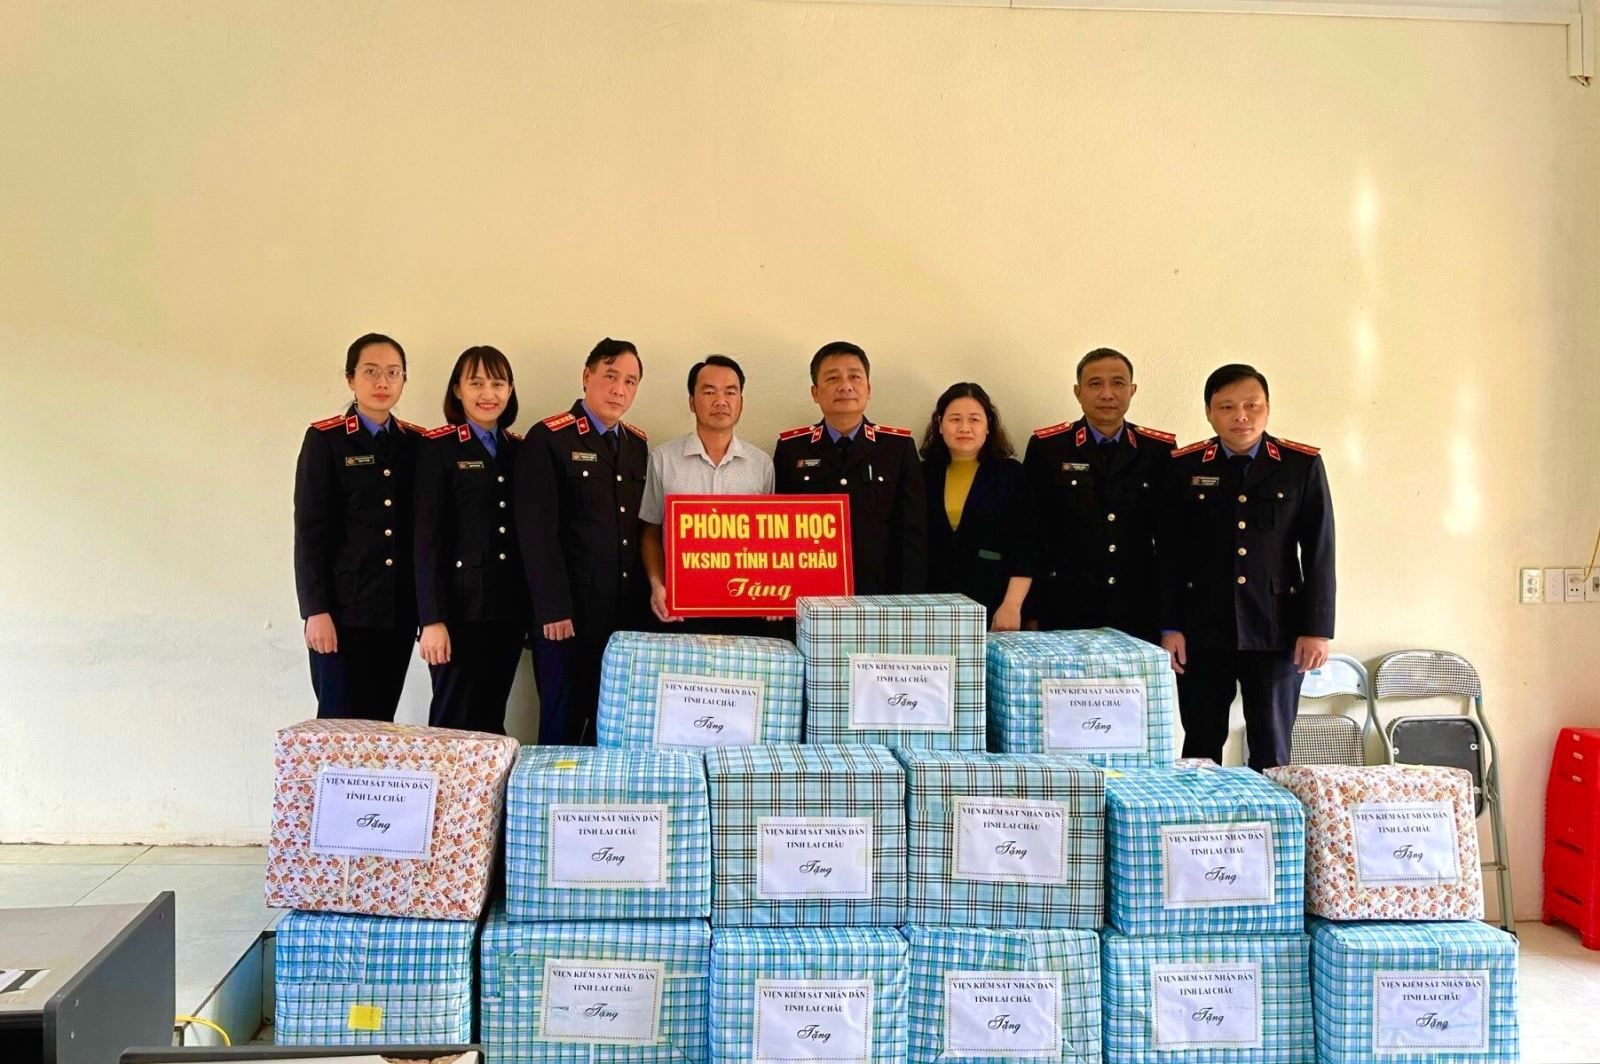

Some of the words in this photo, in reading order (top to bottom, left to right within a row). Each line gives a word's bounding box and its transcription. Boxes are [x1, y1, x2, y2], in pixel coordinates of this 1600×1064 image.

[680, 508, 750, 539] PHÒNG
[756, 514, 789, 539] TIN
[796, 514, 837, 545] HỌC
[682, 552, 731, 569] VKSND
[735, 547, 768, 569] TỈNH
[773, 552, 795, 569] LAI
[799, 549, 838, 569] CHÂU
[727, 577, 792, 601] Tặng
